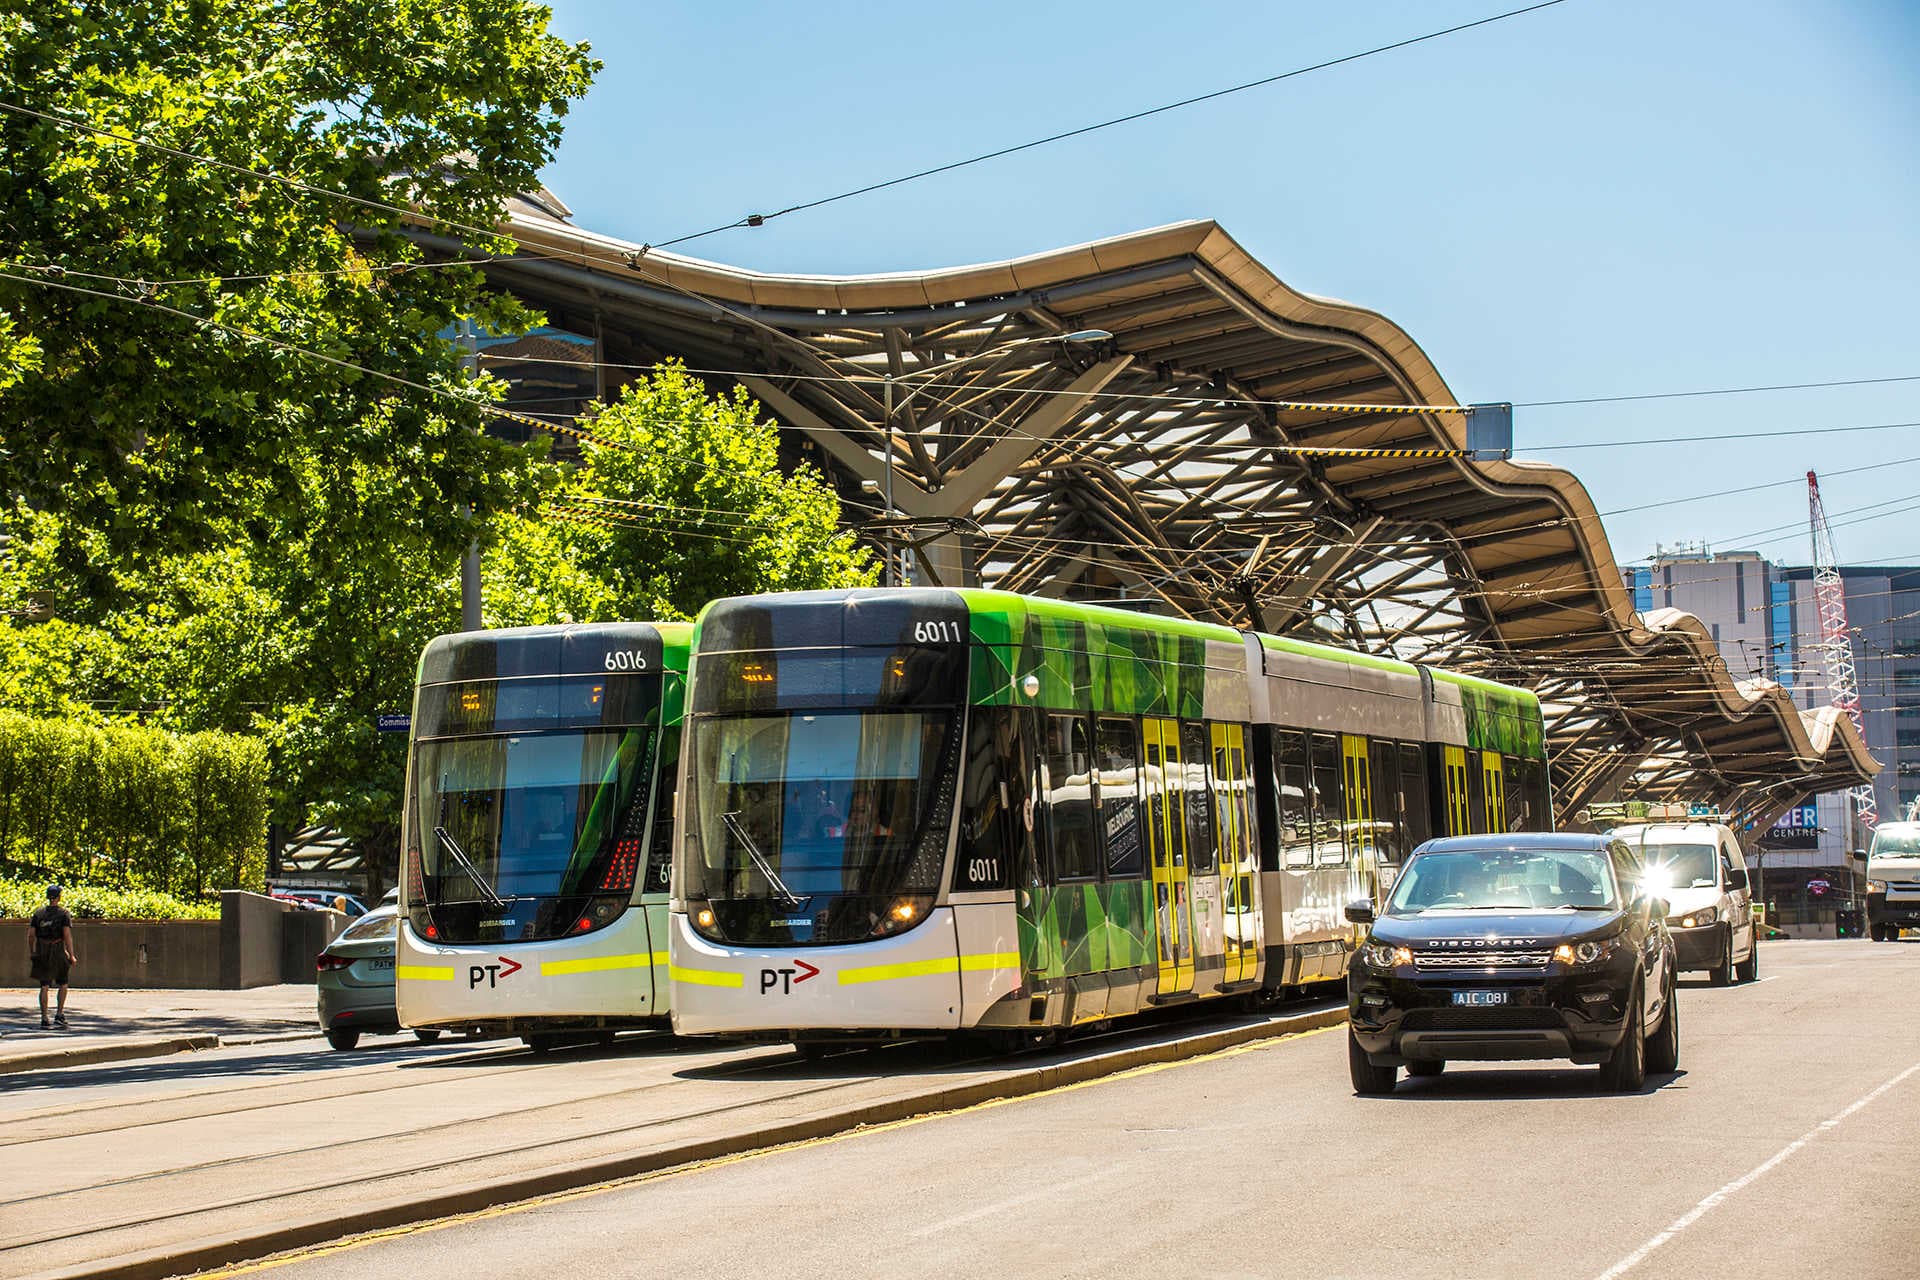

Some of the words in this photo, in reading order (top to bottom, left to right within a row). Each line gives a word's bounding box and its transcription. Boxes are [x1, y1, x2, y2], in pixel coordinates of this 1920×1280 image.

[914, 621, 961, 643] 6011
[604, 650, 647, 671] 6016
[380, 718, 410, 727] Commiss
[1773, 828, 1817, 838] CENTRE
[660, 863, 673, 884] 60
[969, 858, 999, 882] 6011
[1429, 939, 1537, 948] DISCOVERY
